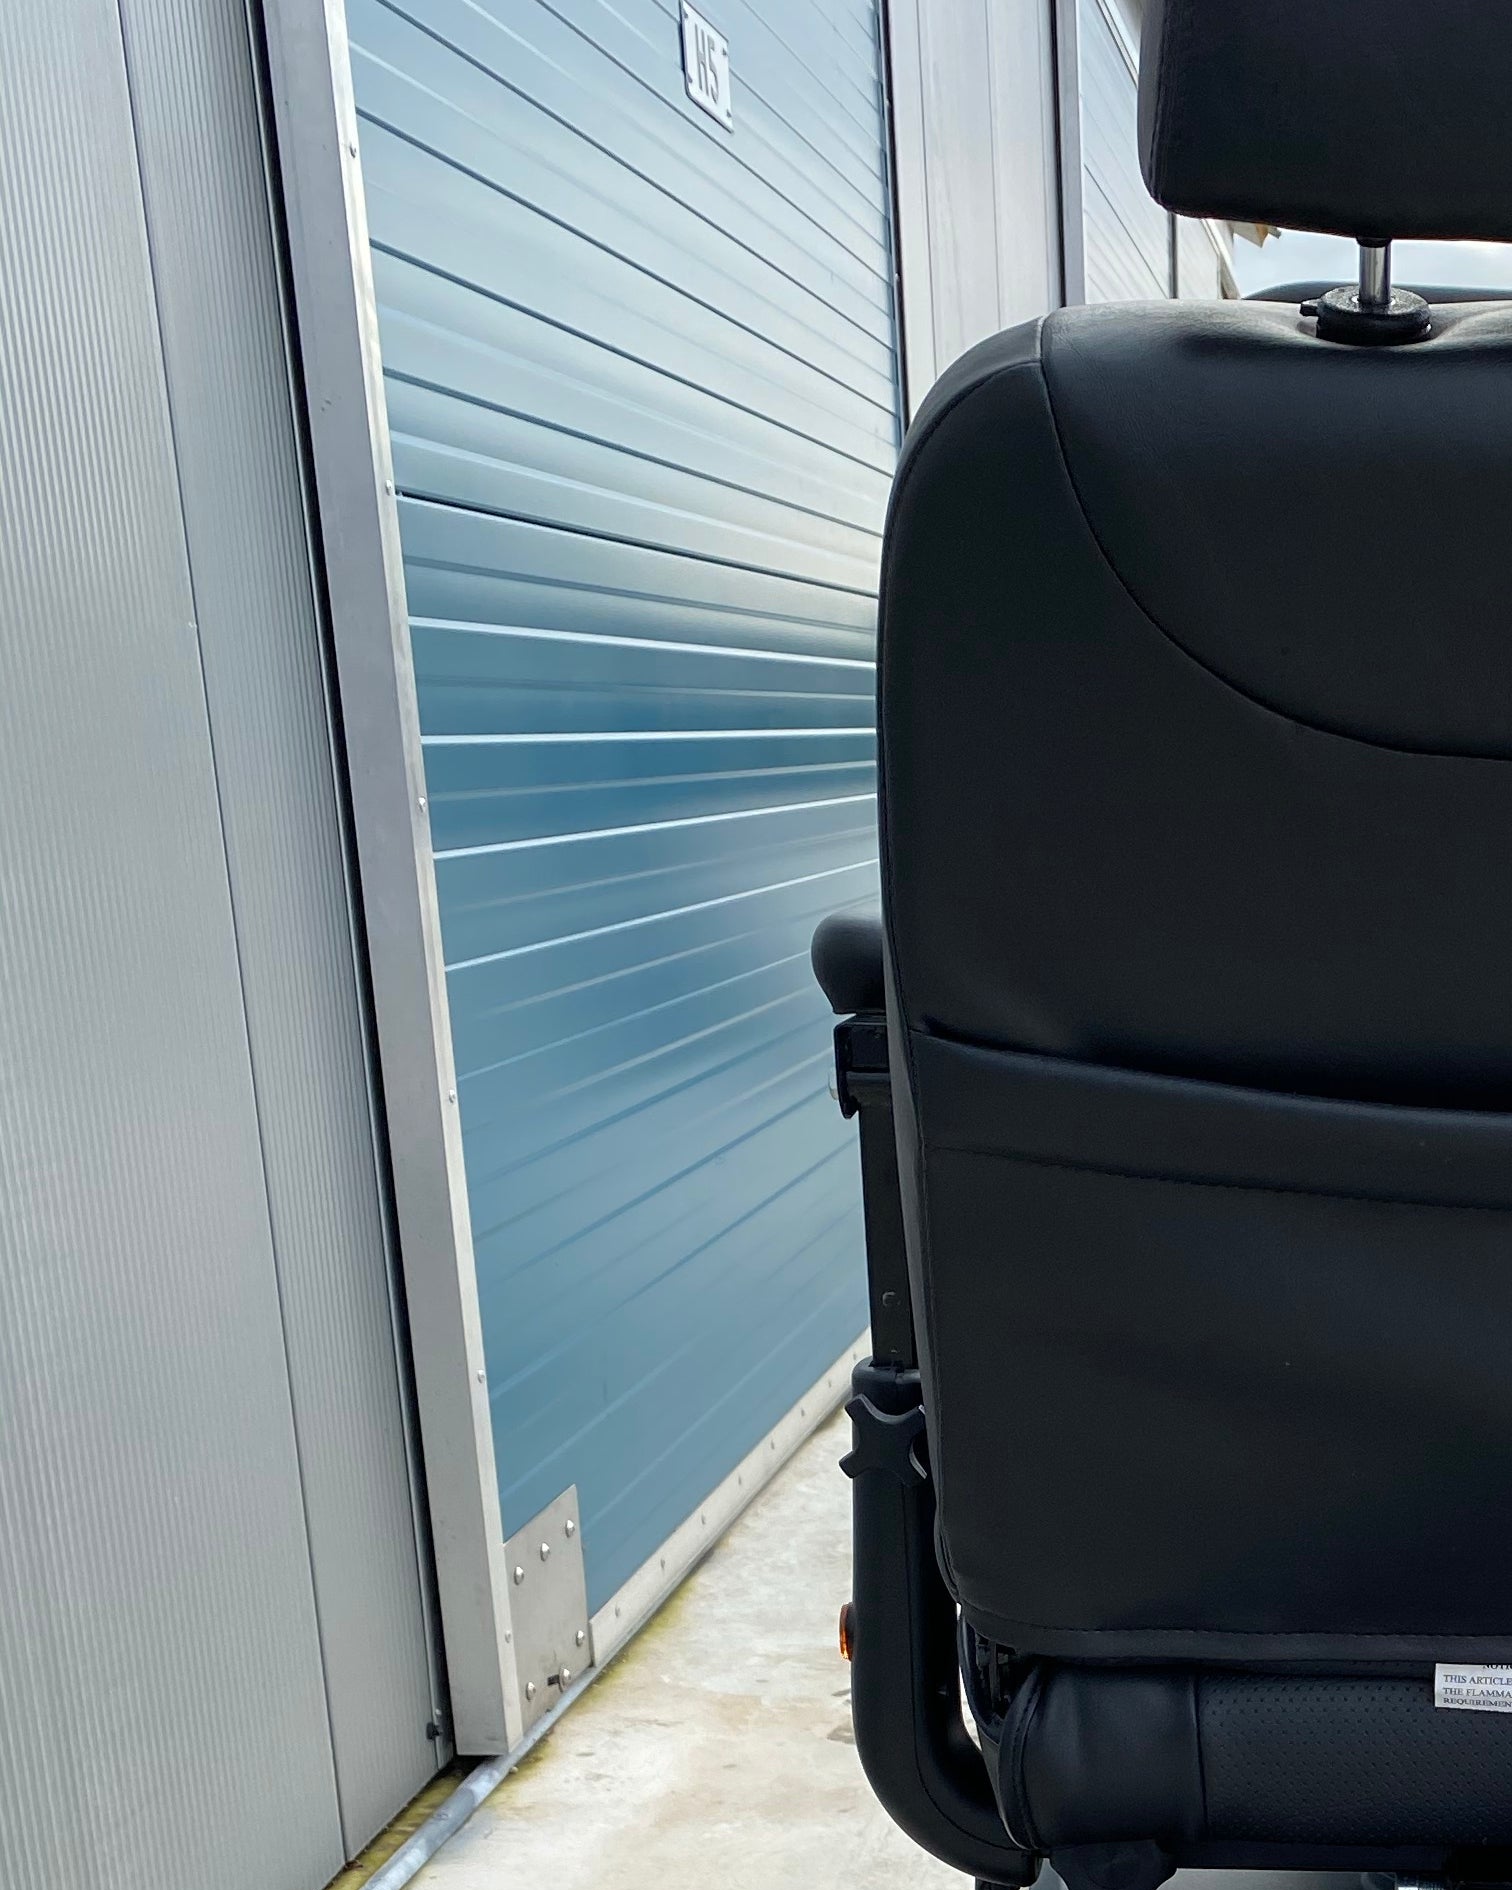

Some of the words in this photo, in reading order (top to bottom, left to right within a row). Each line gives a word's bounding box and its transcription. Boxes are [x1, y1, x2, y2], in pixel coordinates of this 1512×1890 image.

[694, 22, 719, 105] H5
[1443, 1674, 1467, 1684] THIS
[1469, 1676, 1512, 1686] ARTICLE
[1442, 1687, 1463, 1696] THE
